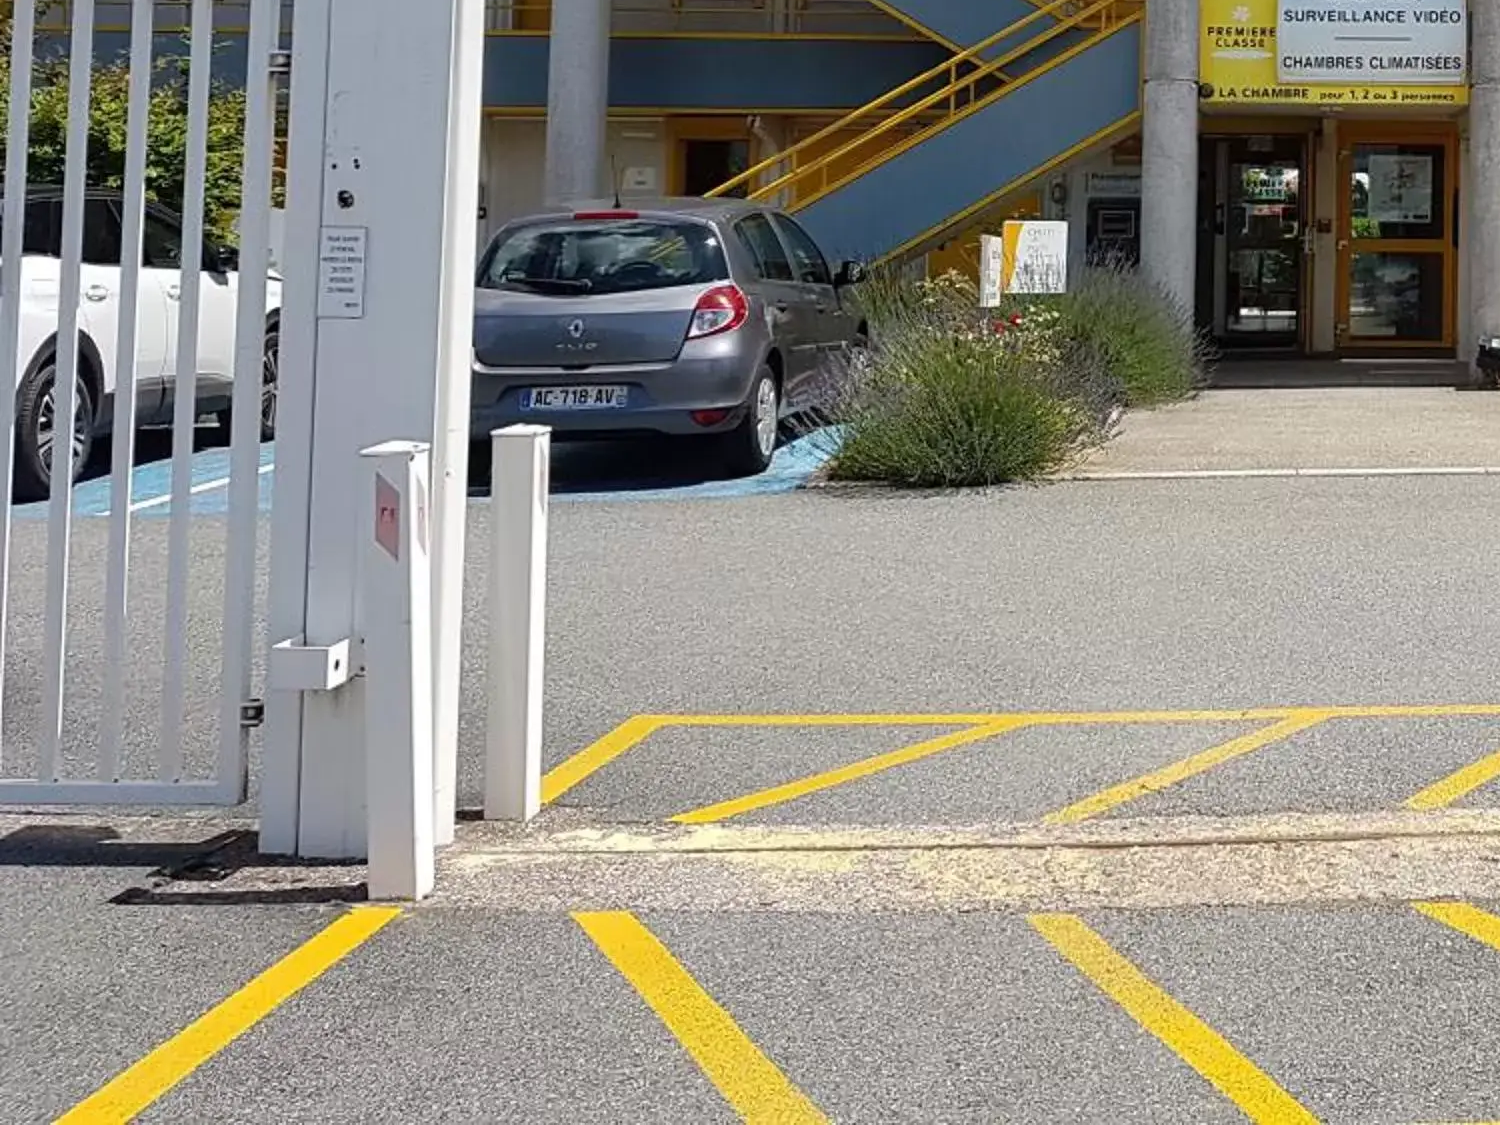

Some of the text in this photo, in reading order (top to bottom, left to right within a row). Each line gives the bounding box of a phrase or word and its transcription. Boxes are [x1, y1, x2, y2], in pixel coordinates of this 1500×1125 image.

[1283, 7, 1462, 23] SURVEILLANCE VIDÉO
[1207, 26, 1277, 37] PREMIERE
[1215, 38, 1265, 48] CLASSE
[1283, 54, 1462, 70] CHAMBRES CLIMATISÉES
[1219, 87, 1237, 98] LA
[1242, 87, 1310, 99] CHAMBRE
[1319, 91, 1344, 101] pour
[1362, 88, 1370, 99] 2
[1373, 92, 1387, 100] ou
[1390, 89, 1398, 100] 3
